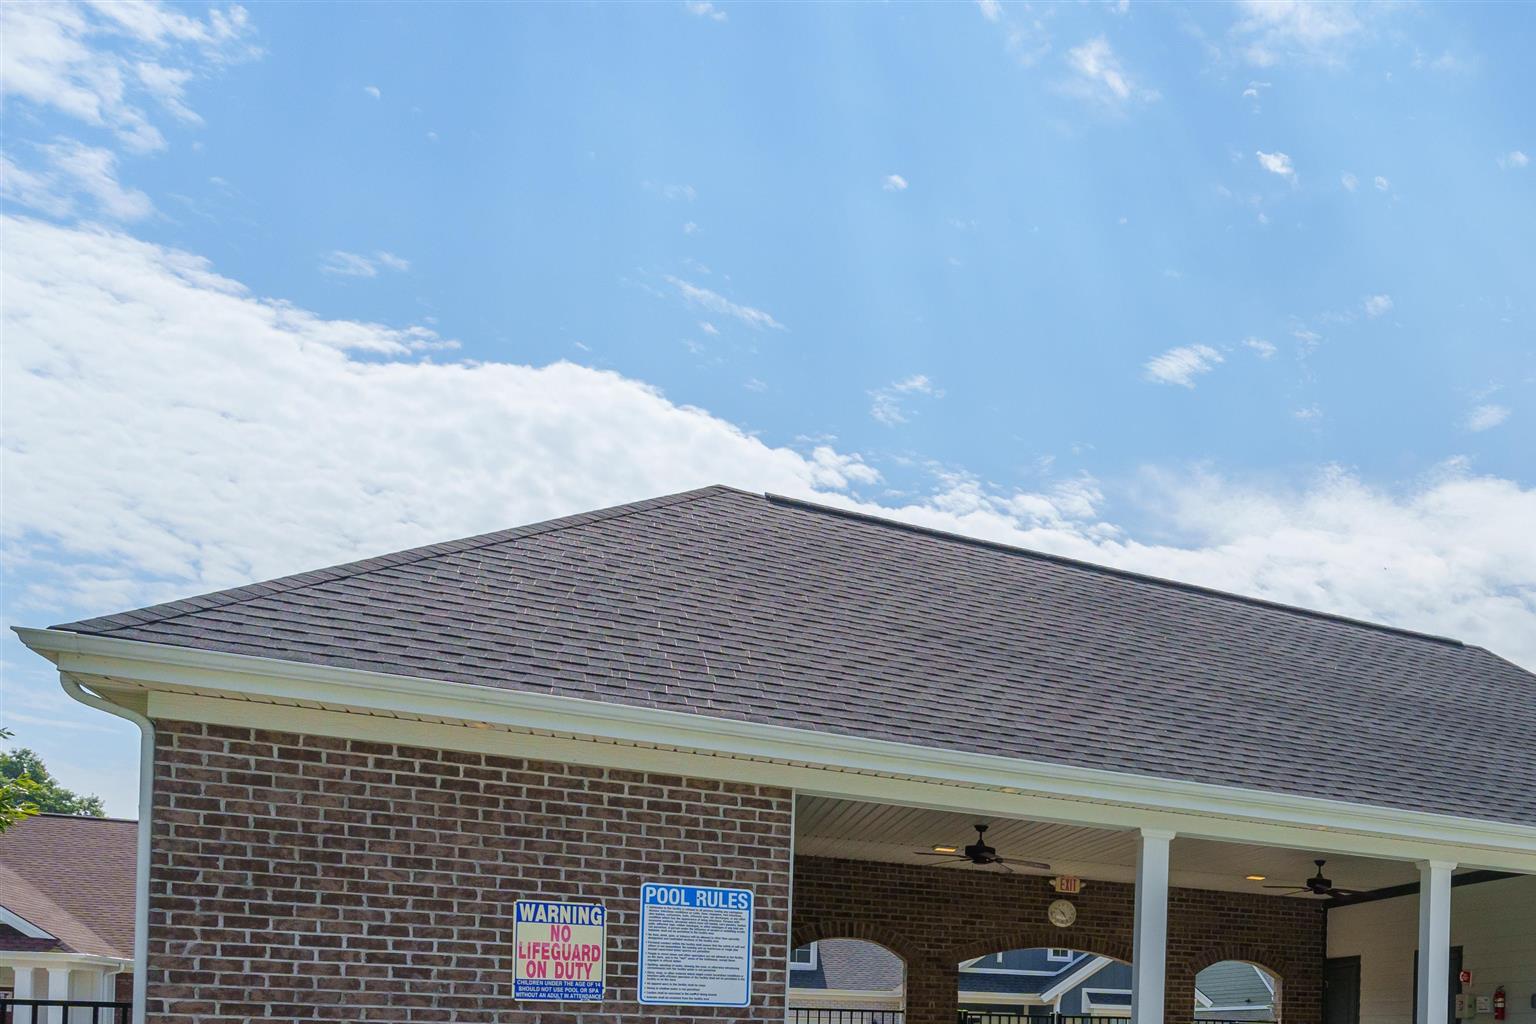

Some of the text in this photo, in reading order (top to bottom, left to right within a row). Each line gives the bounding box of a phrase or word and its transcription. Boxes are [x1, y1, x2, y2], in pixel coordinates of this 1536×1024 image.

[1060, 876, 1076, 891] EXIT
[645, 886, 748, 910] POOL RULES
[519, 903, 603, 926] WARNING
[550, 925, 572, 943] NO
[518, 941, 601, 962] LIFEGUARD
[525, 960, 593, 980] ON DUTY
